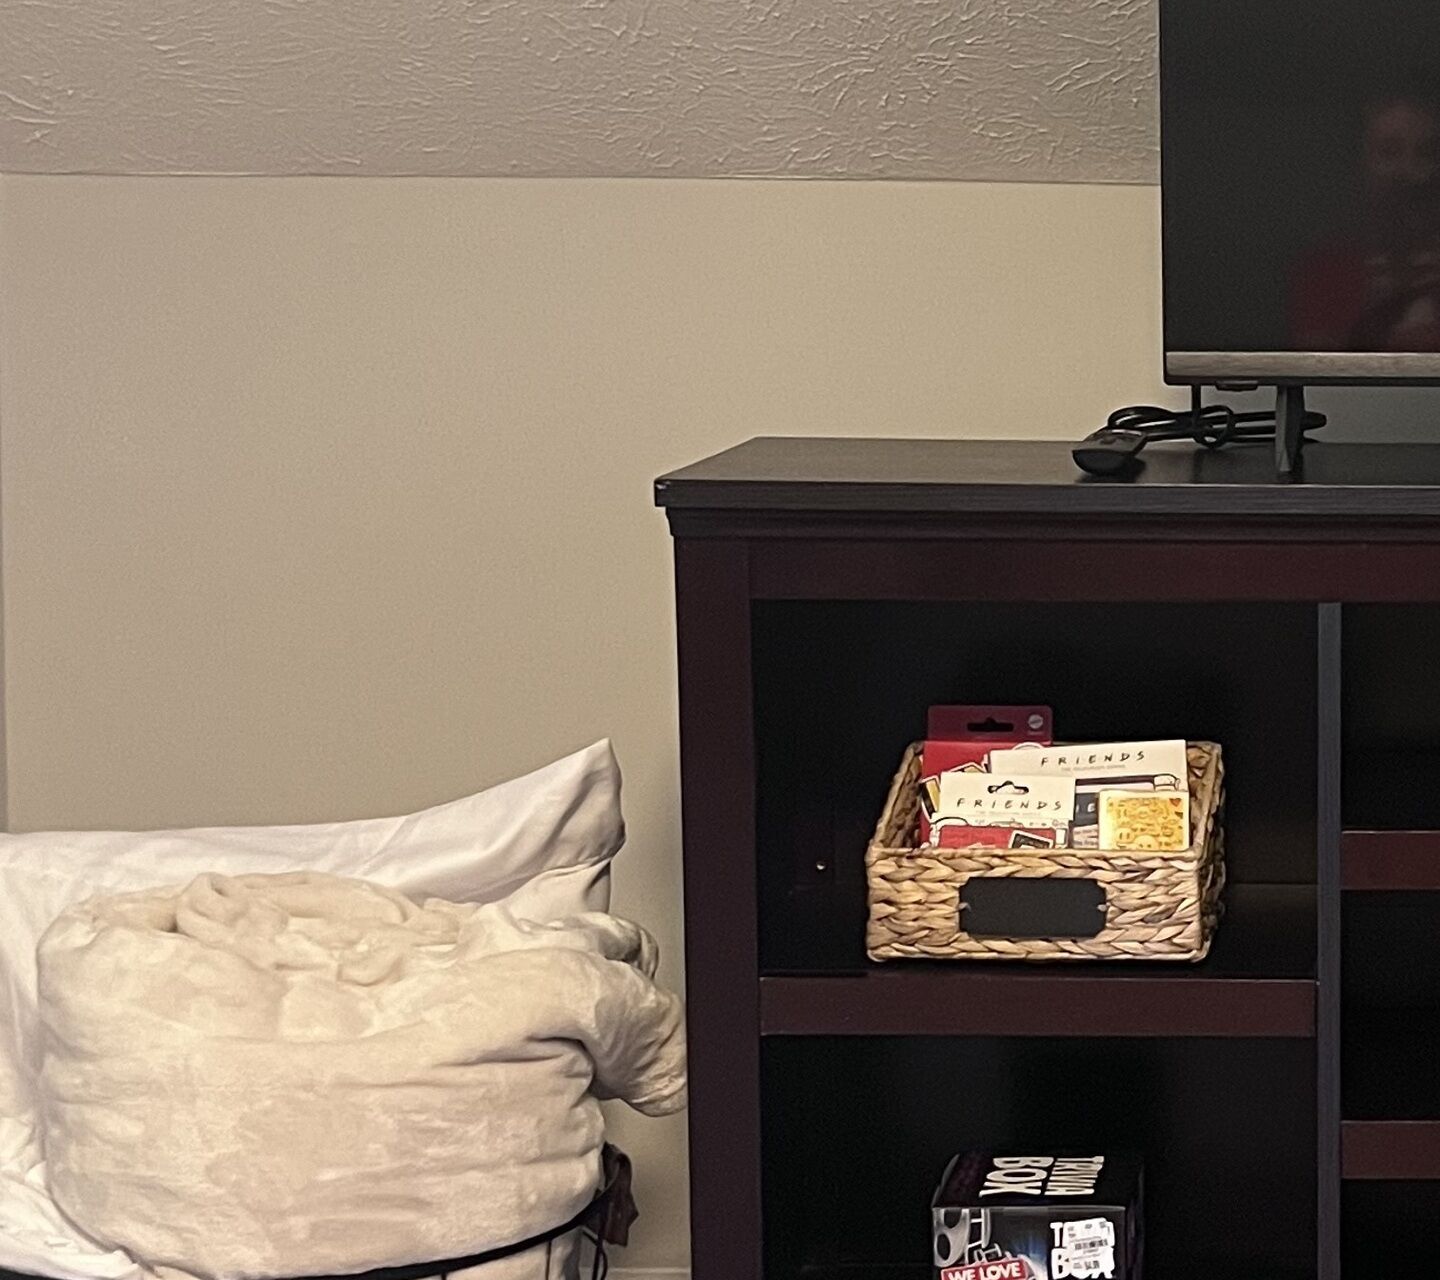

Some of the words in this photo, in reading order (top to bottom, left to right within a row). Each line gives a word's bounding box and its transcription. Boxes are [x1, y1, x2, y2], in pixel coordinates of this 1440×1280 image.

[1040, 750, 1145, 767] FRIENDS
[956, 797, 1063, 812] FRIENDS
[978, 1156, 1055, 1198] BOX
[1044, 1156, 1105, 1196] TRIVIA
